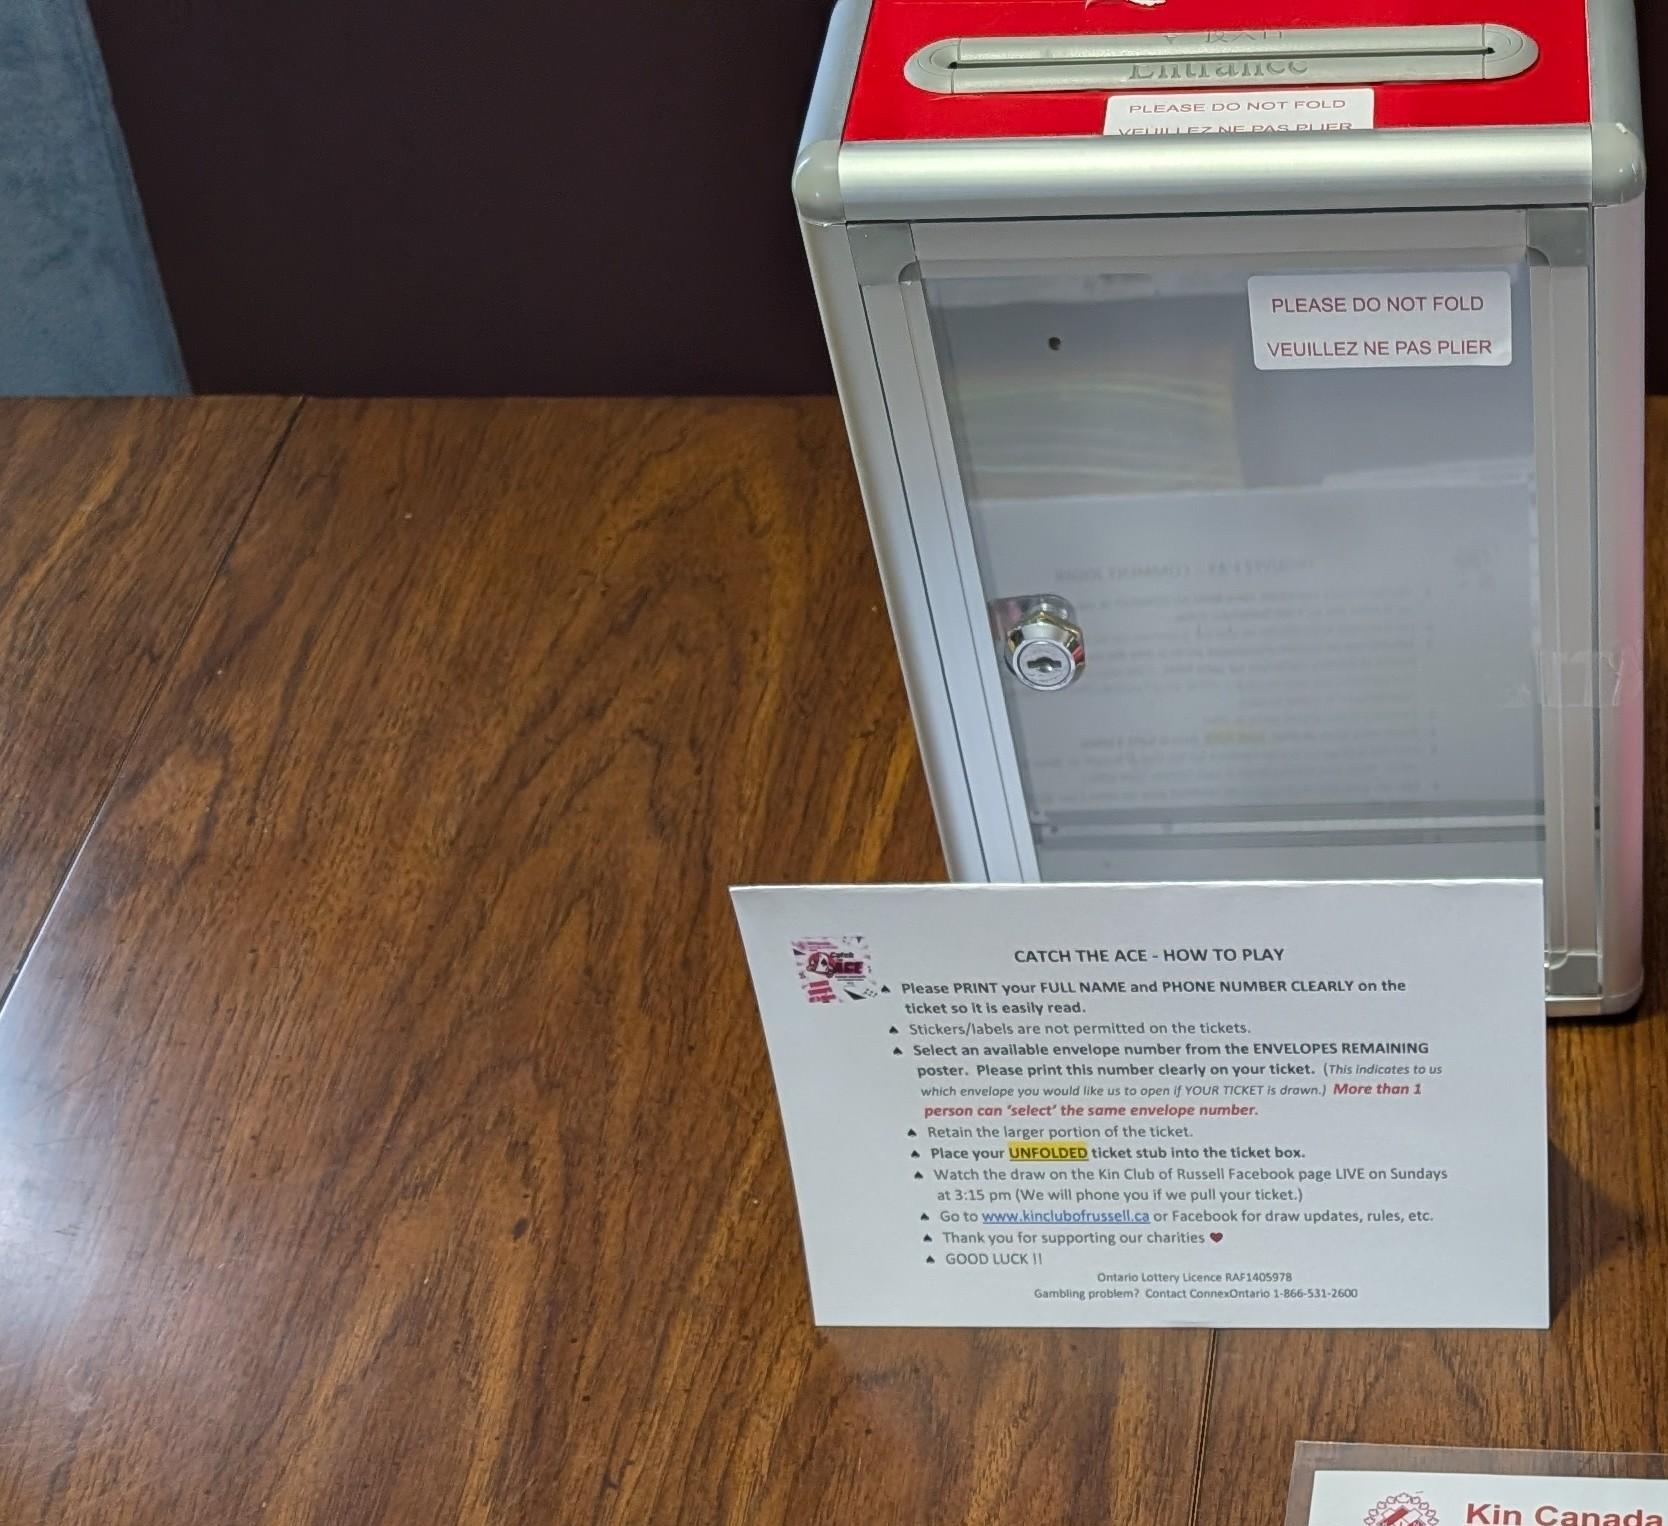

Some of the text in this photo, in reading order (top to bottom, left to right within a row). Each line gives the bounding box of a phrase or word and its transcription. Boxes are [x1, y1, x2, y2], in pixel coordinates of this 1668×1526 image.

[1129, 99, 1346, 114] PLEASE DO NOT FOLD
[1271, 295, 1484, 313] PLEASE DO NOT FOLD
[1266, 339, 1492, 357] VEUILLEZ NE PAS PLIER
[1014, 950, 1072, 963] CATCH
[1074, 949, 1110, 963] THE
[1114, 949, 1148, 962] ACE
[1163, 948, 1208, 962] HOW
[1212, 948, 1237, 962] TO
[1242, 948, 1284, 962] PLAY
[931, 1146, 1305, 1162] Place your UNFOLDED ticket stub into the ticket box.
[939, 1209, 1434, 1225] Go to www.kinclubofrussell.ca or Facebook for draw updates, rules, etc.
[945, 1252, 989, 1265] GOOD
[992, 1252, 1029, 1265] LUCK
[1466, 1503, 1522, 1526] Kin
